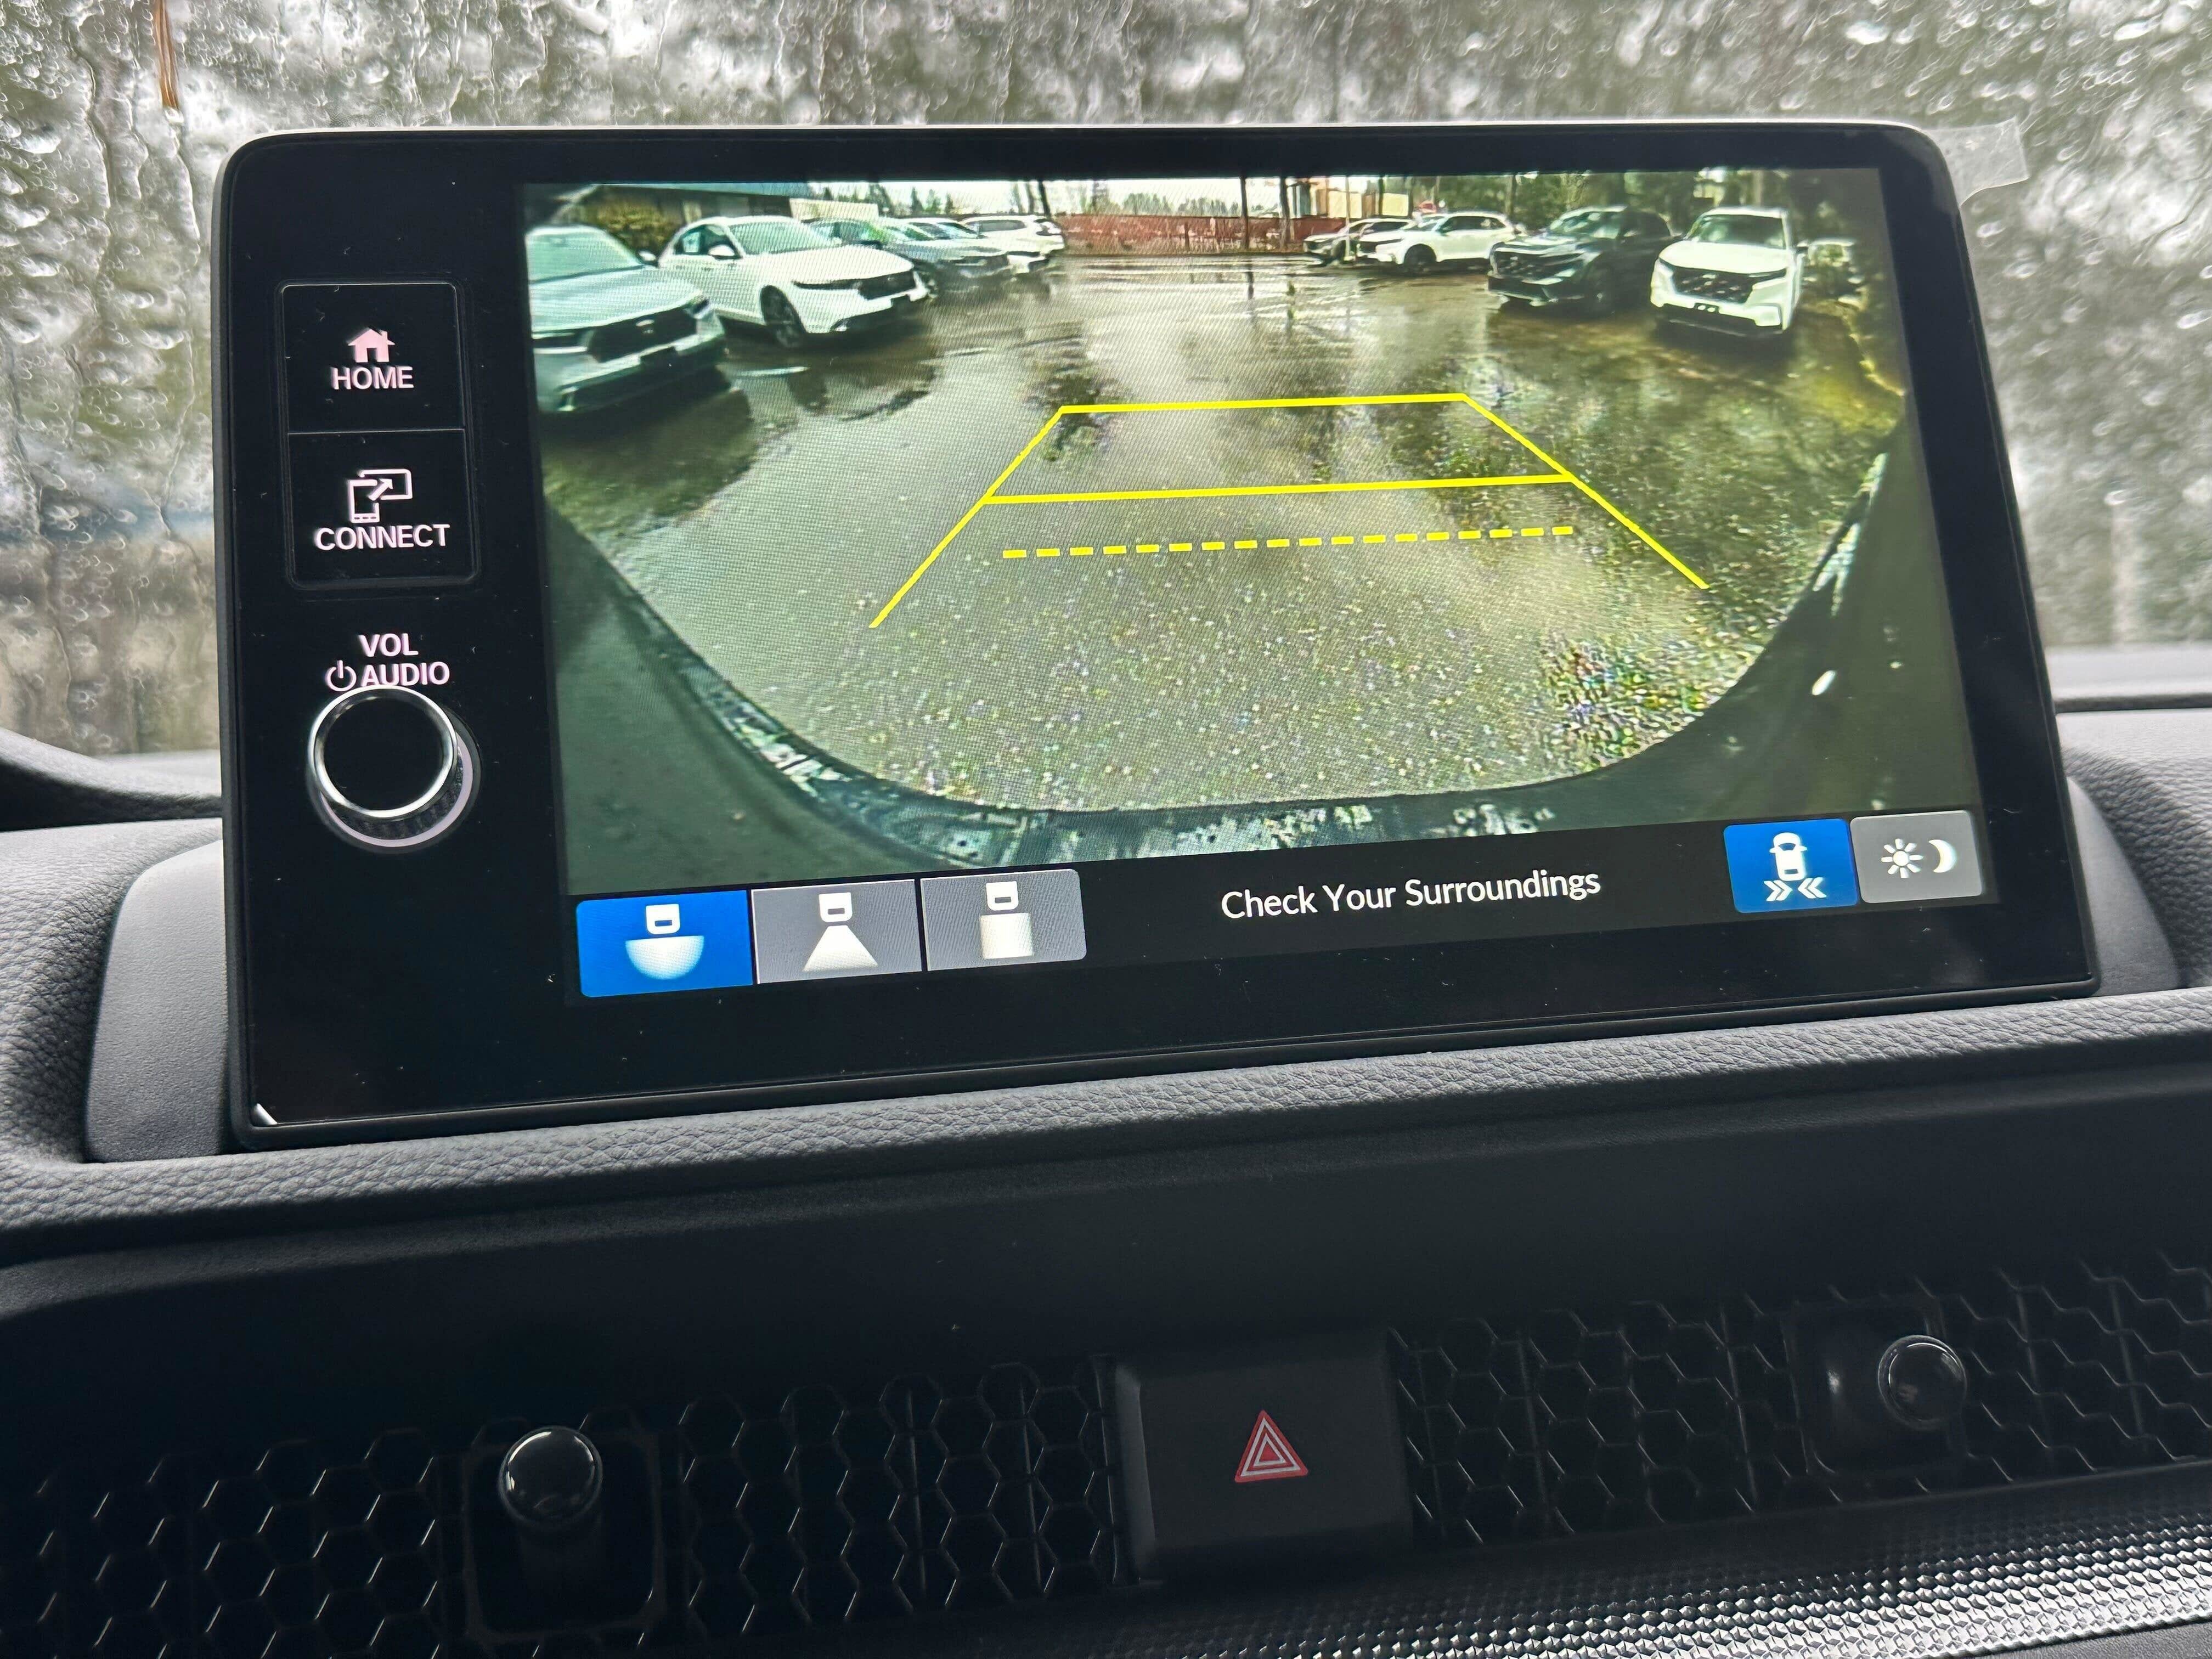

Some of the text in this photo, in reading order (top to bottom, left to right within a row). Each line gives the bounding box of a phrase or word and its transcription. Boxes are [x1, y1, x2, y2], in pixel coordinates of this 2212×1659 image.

[331, 366, 414, 390] HOME
[314, 523, 450, 551] CONNECT
[358, 633, 419, 657] VOL
[360, 661, 450, 687] AUDIO
[1221, 869, 1601, 919] Check Your Surroundings
